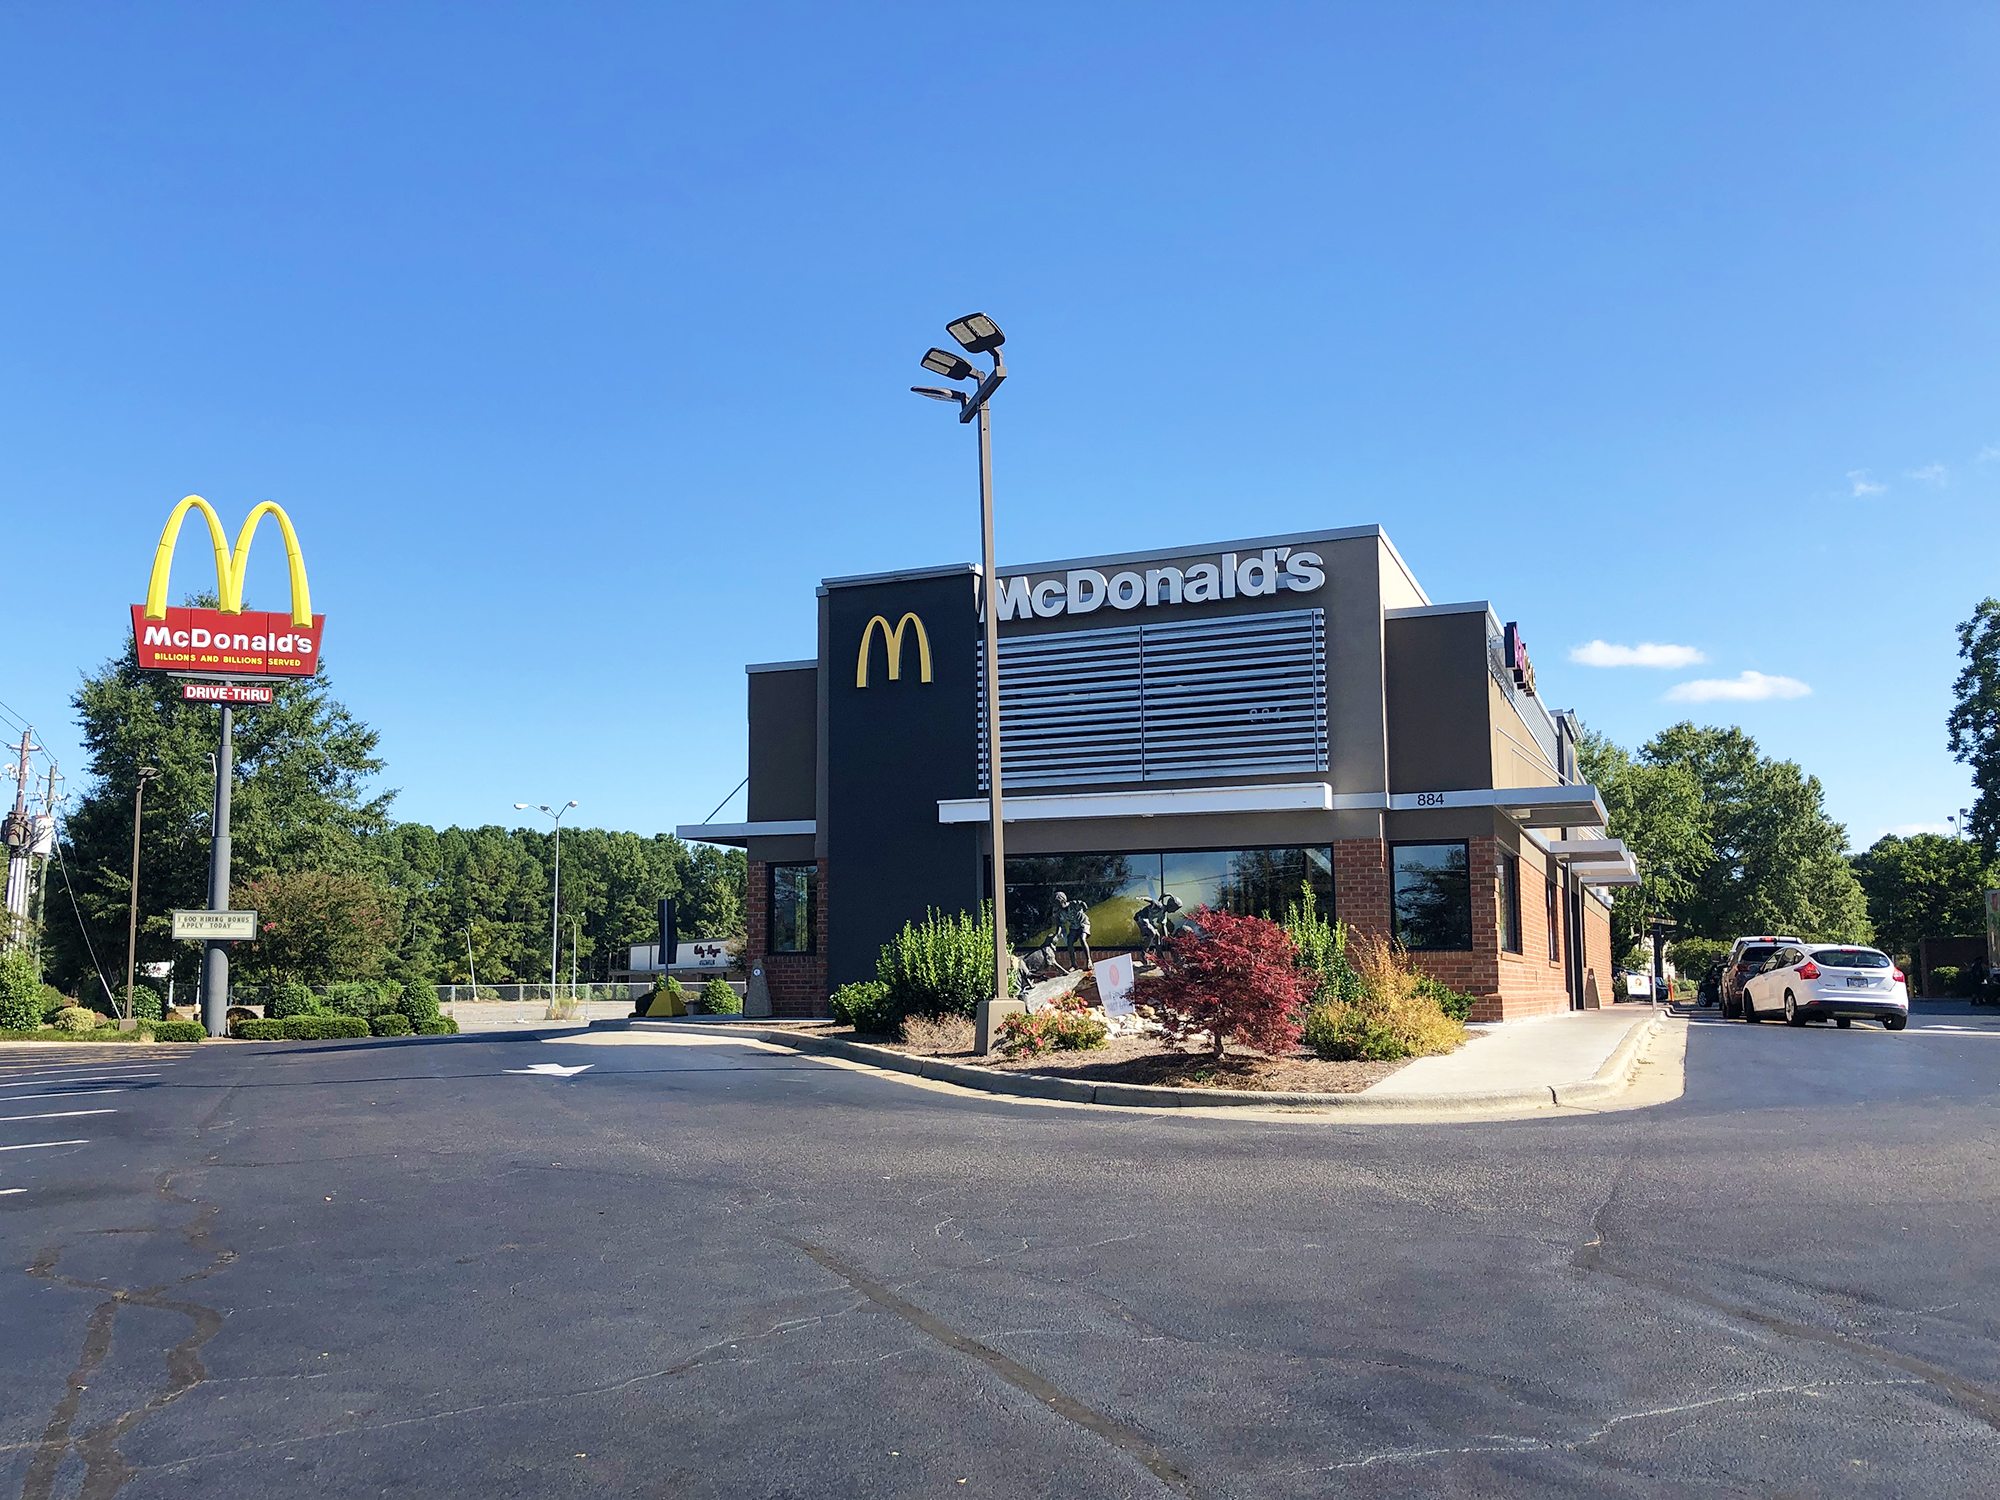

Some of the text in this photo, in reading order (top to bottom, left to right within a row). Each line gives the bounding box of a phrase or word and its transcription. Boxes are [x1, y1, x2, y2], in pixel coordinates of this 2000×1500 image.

[978, 547, 1326, 623] McDonald's
[143, 626, 313, 654] McDonald's
[154, 652, 301, 667] BILLIONS AND BILLIONS SERVED
[186, 686, 270, 702] DRIVE-THRU
[1417, 793, 1445, 806] 884
